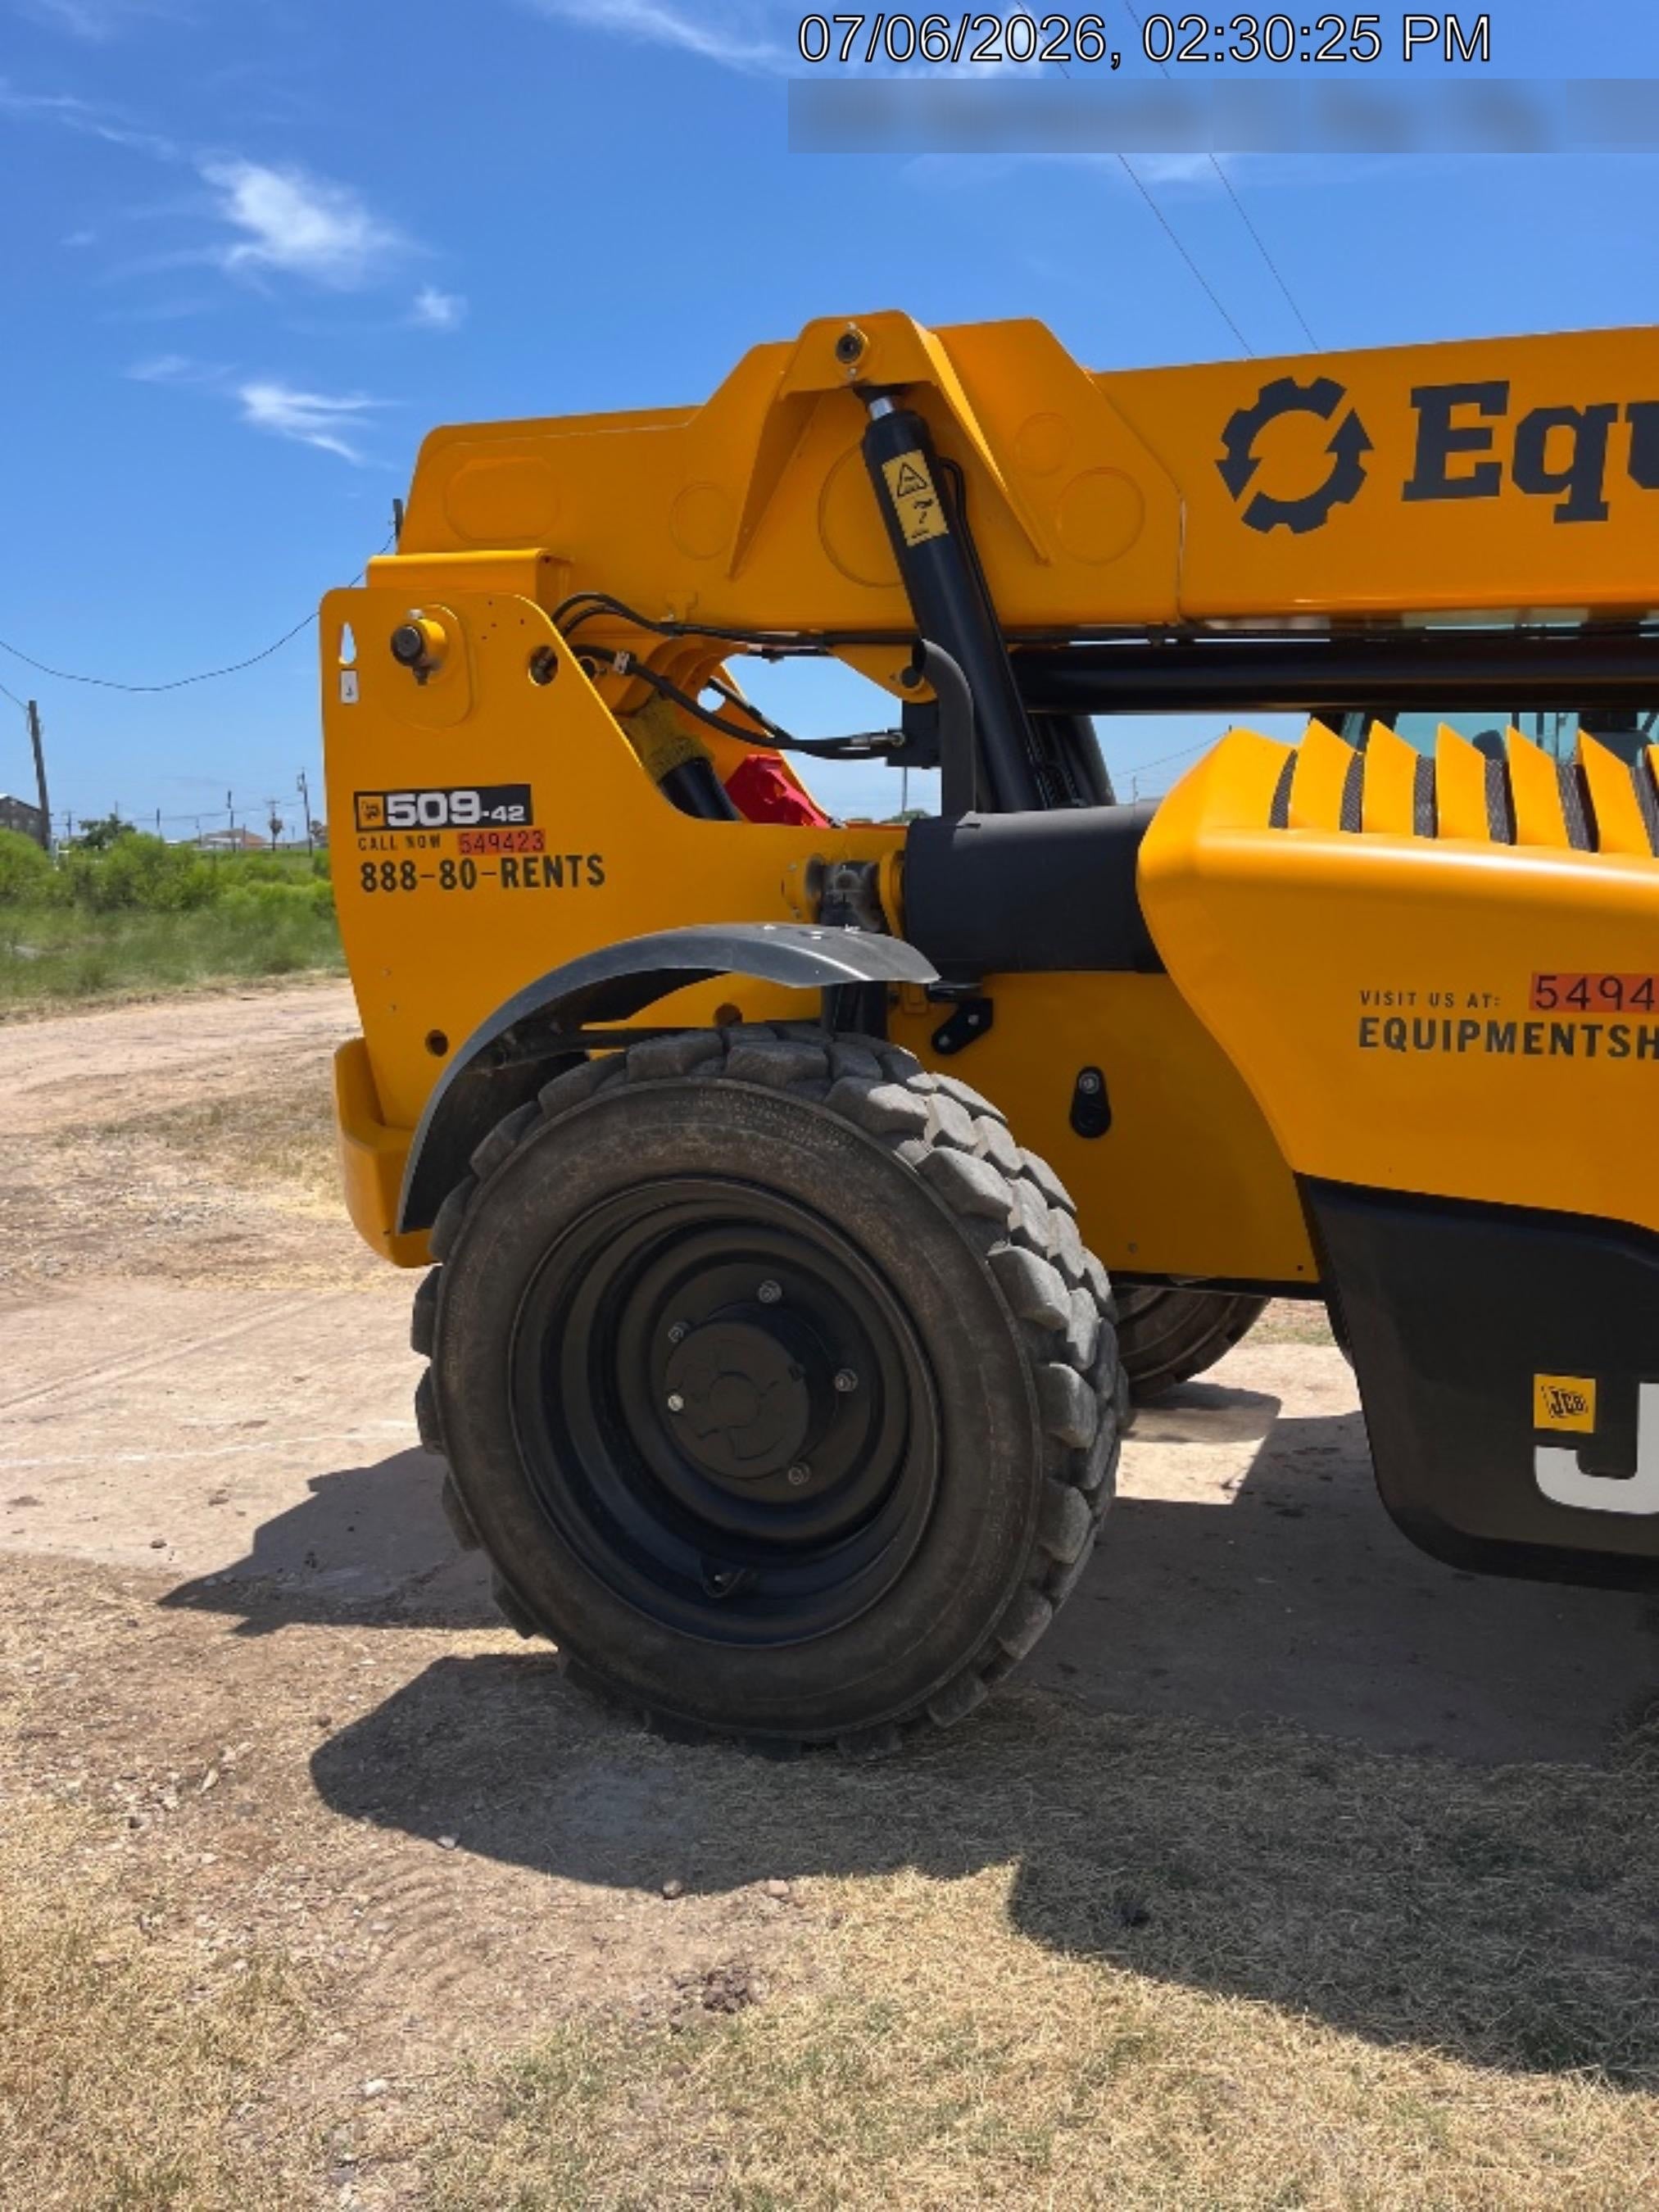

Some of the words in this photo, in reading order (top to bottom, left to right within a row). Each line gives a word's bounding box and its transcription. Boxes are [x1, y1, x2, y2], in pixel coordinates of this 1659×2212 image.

[386, 790, 526, 827] 509-42
[358, 834, 398, 851] CALL
[406, 832, 441, 849] NOW
[459, 830, 546, 854] 549423
[360, 854, 606, 893] 888-80-RENTS
[1360, 990, 1416, 1006] VISIT
[1429, 992, 1455, 1008] US
[1466, 992, 1501, 1009] AT:
[1534, 975, 1655, 1011] 5494
[1358, 1017, 1659, 1060] EQUIPMENTSH
